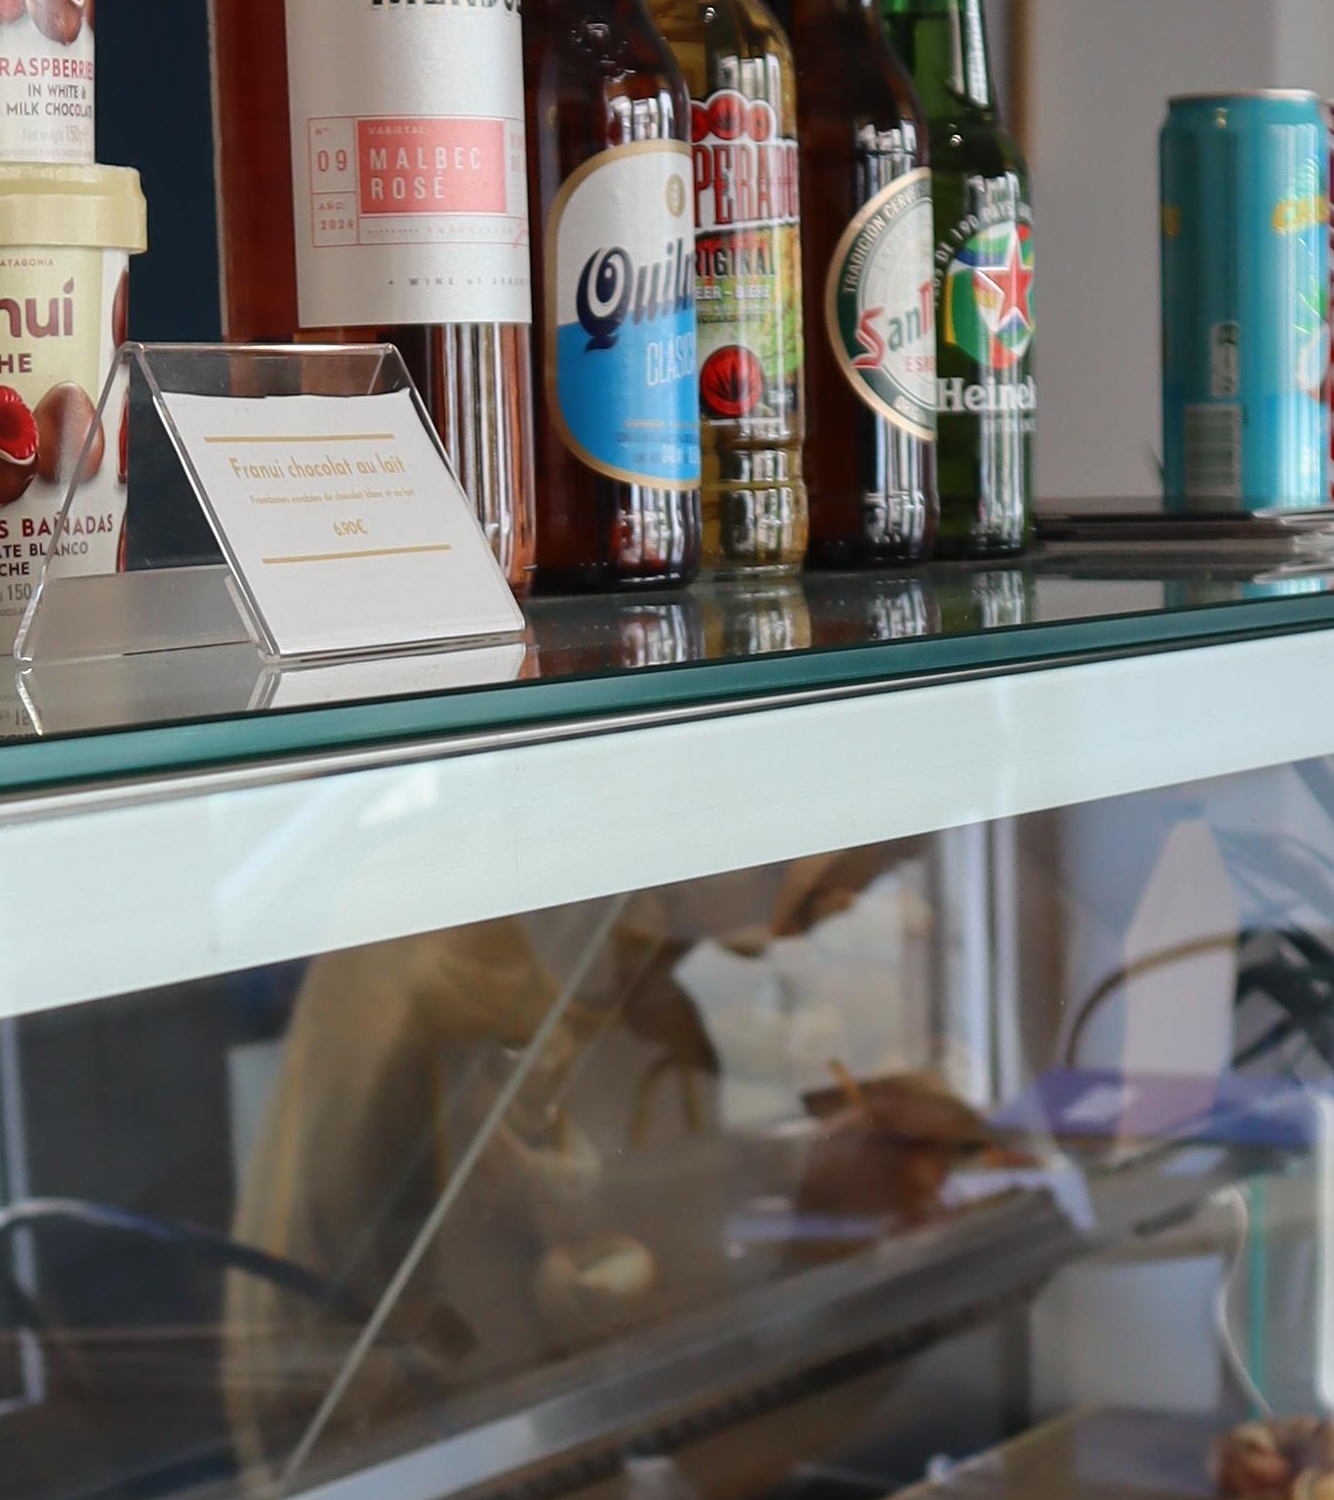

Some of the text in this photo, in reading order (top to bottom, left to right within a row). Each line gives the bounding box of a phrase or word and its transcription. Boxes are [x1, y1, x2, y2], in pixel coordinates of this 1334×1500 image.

[28, 83, 42, 97] IN
[48, 84, 79, 98] WHITE
[6, 102, 39, 116] MILK
[318, 149, 348, 173] 09
[369, 146, 482, 170] MALBEC
[371, 171, 445, 200] ROSÉ
[696, 286, 722, 299] EER
[228, 452, 406, 480] Franui chocolat au lait
